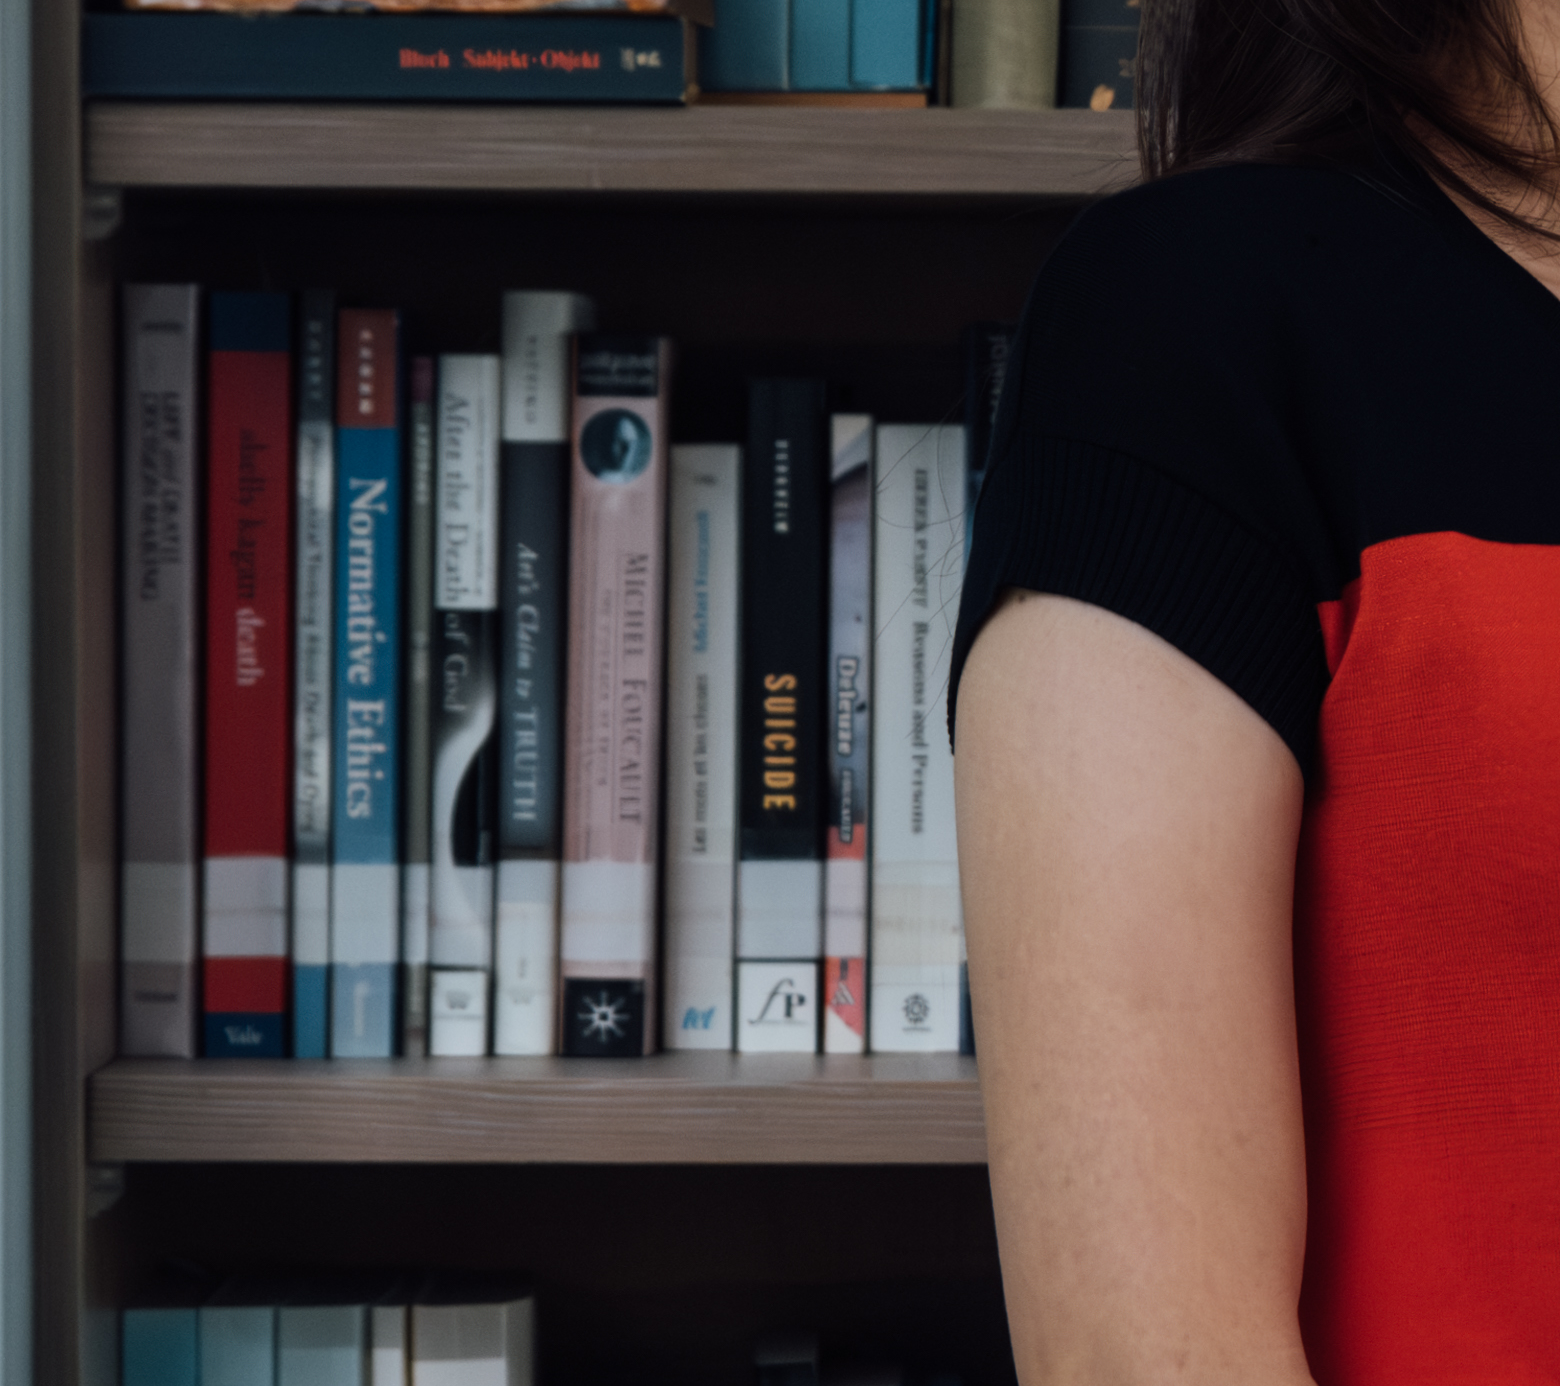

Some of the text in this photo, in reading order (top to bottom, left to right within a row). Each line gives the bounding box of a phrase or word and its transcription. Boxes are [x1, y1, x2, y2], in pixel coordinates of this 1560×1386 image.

[443, 391, 471, 713] After the Death of God
[236, 605, 268, 687] death
[346, 477, 388, 819] Normative Ethics
[512, 543, 541, 821] Art's Claim TRUTH
[617, 552, 649, 825] MICHEL FOUCAULT
[835, 655, 860, 755] Deleuze
[763, 673, 797, 811] SUICIDE
[909, 753, 929, 834] Persons
[910, 711, 931, 747] and
